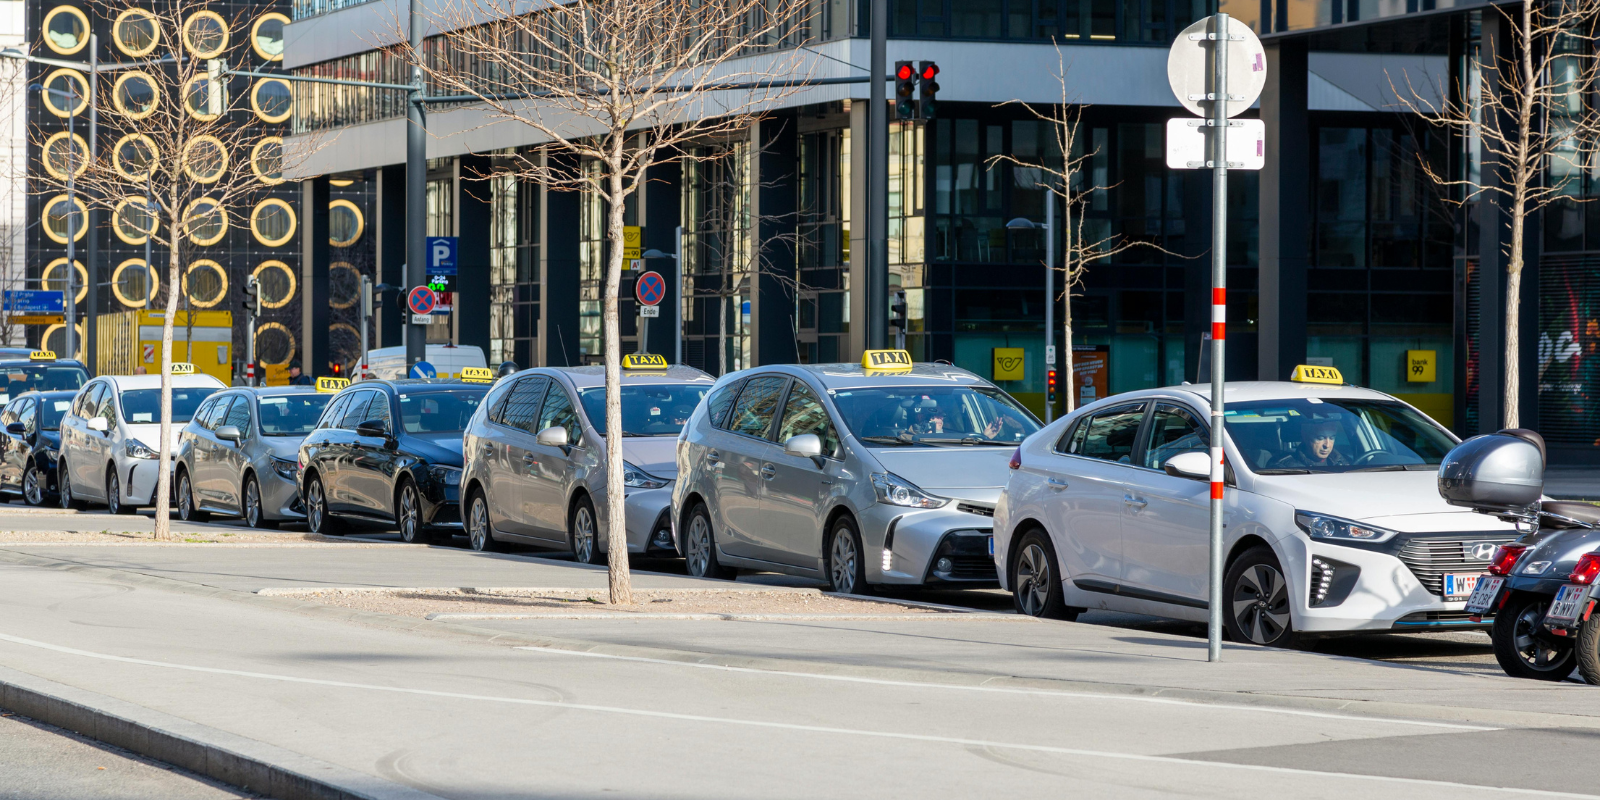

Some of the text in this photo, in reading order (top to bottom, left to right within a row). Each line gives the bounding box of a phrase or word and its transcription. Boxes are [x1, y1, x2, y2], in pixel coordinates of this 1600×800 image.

[433, 245, 450, 267] P
[630, 355, 662, 364] TAXI
[872, 352, 909, 364] TAXI
[465, 369, 489, 377] TAXI
[1305, 367, 1338, 379] TAXI
[1412, 366, 1424, 376] 99
[322, 379, 349, 389] TAXI
[1456, 578, 1466, 592] W
[1483, 579, 1493, 592] W
[1471, 592, 1480, 604] 5
[1565, 588, 1575, 600] W
[1554, 601, 1563, 615] 6
